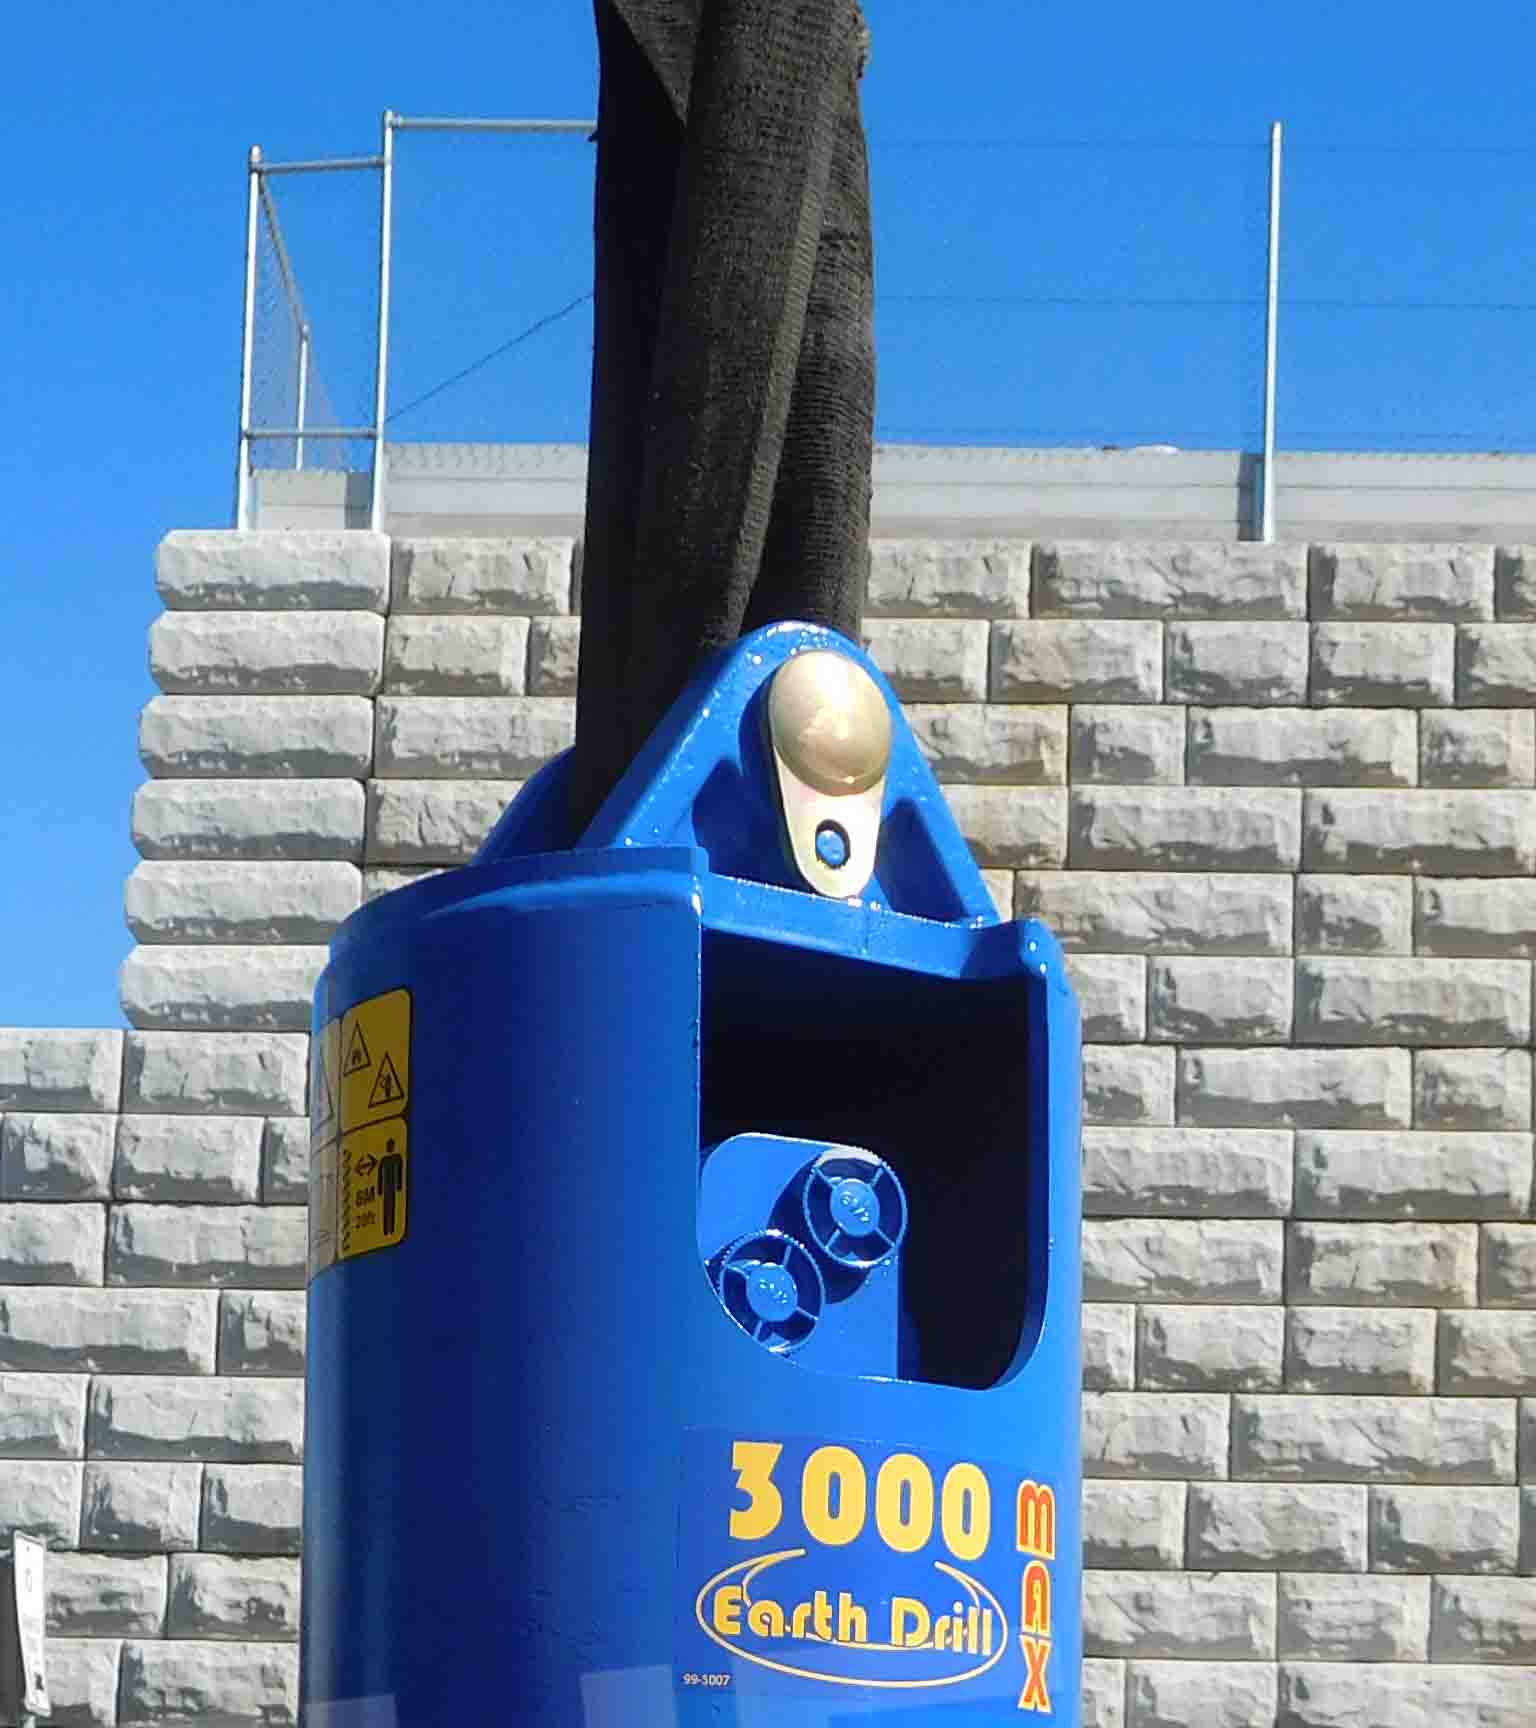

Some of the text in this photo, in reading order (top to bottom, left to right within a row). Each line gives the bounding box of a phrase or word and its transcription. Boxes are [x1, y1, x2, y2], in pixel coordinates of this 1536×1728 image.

[729, 1440, 992, 1562] 3000
[713, 1584, 993, 1656] Earth Drill
[1016, 1479, 1056, 1714] MAX
